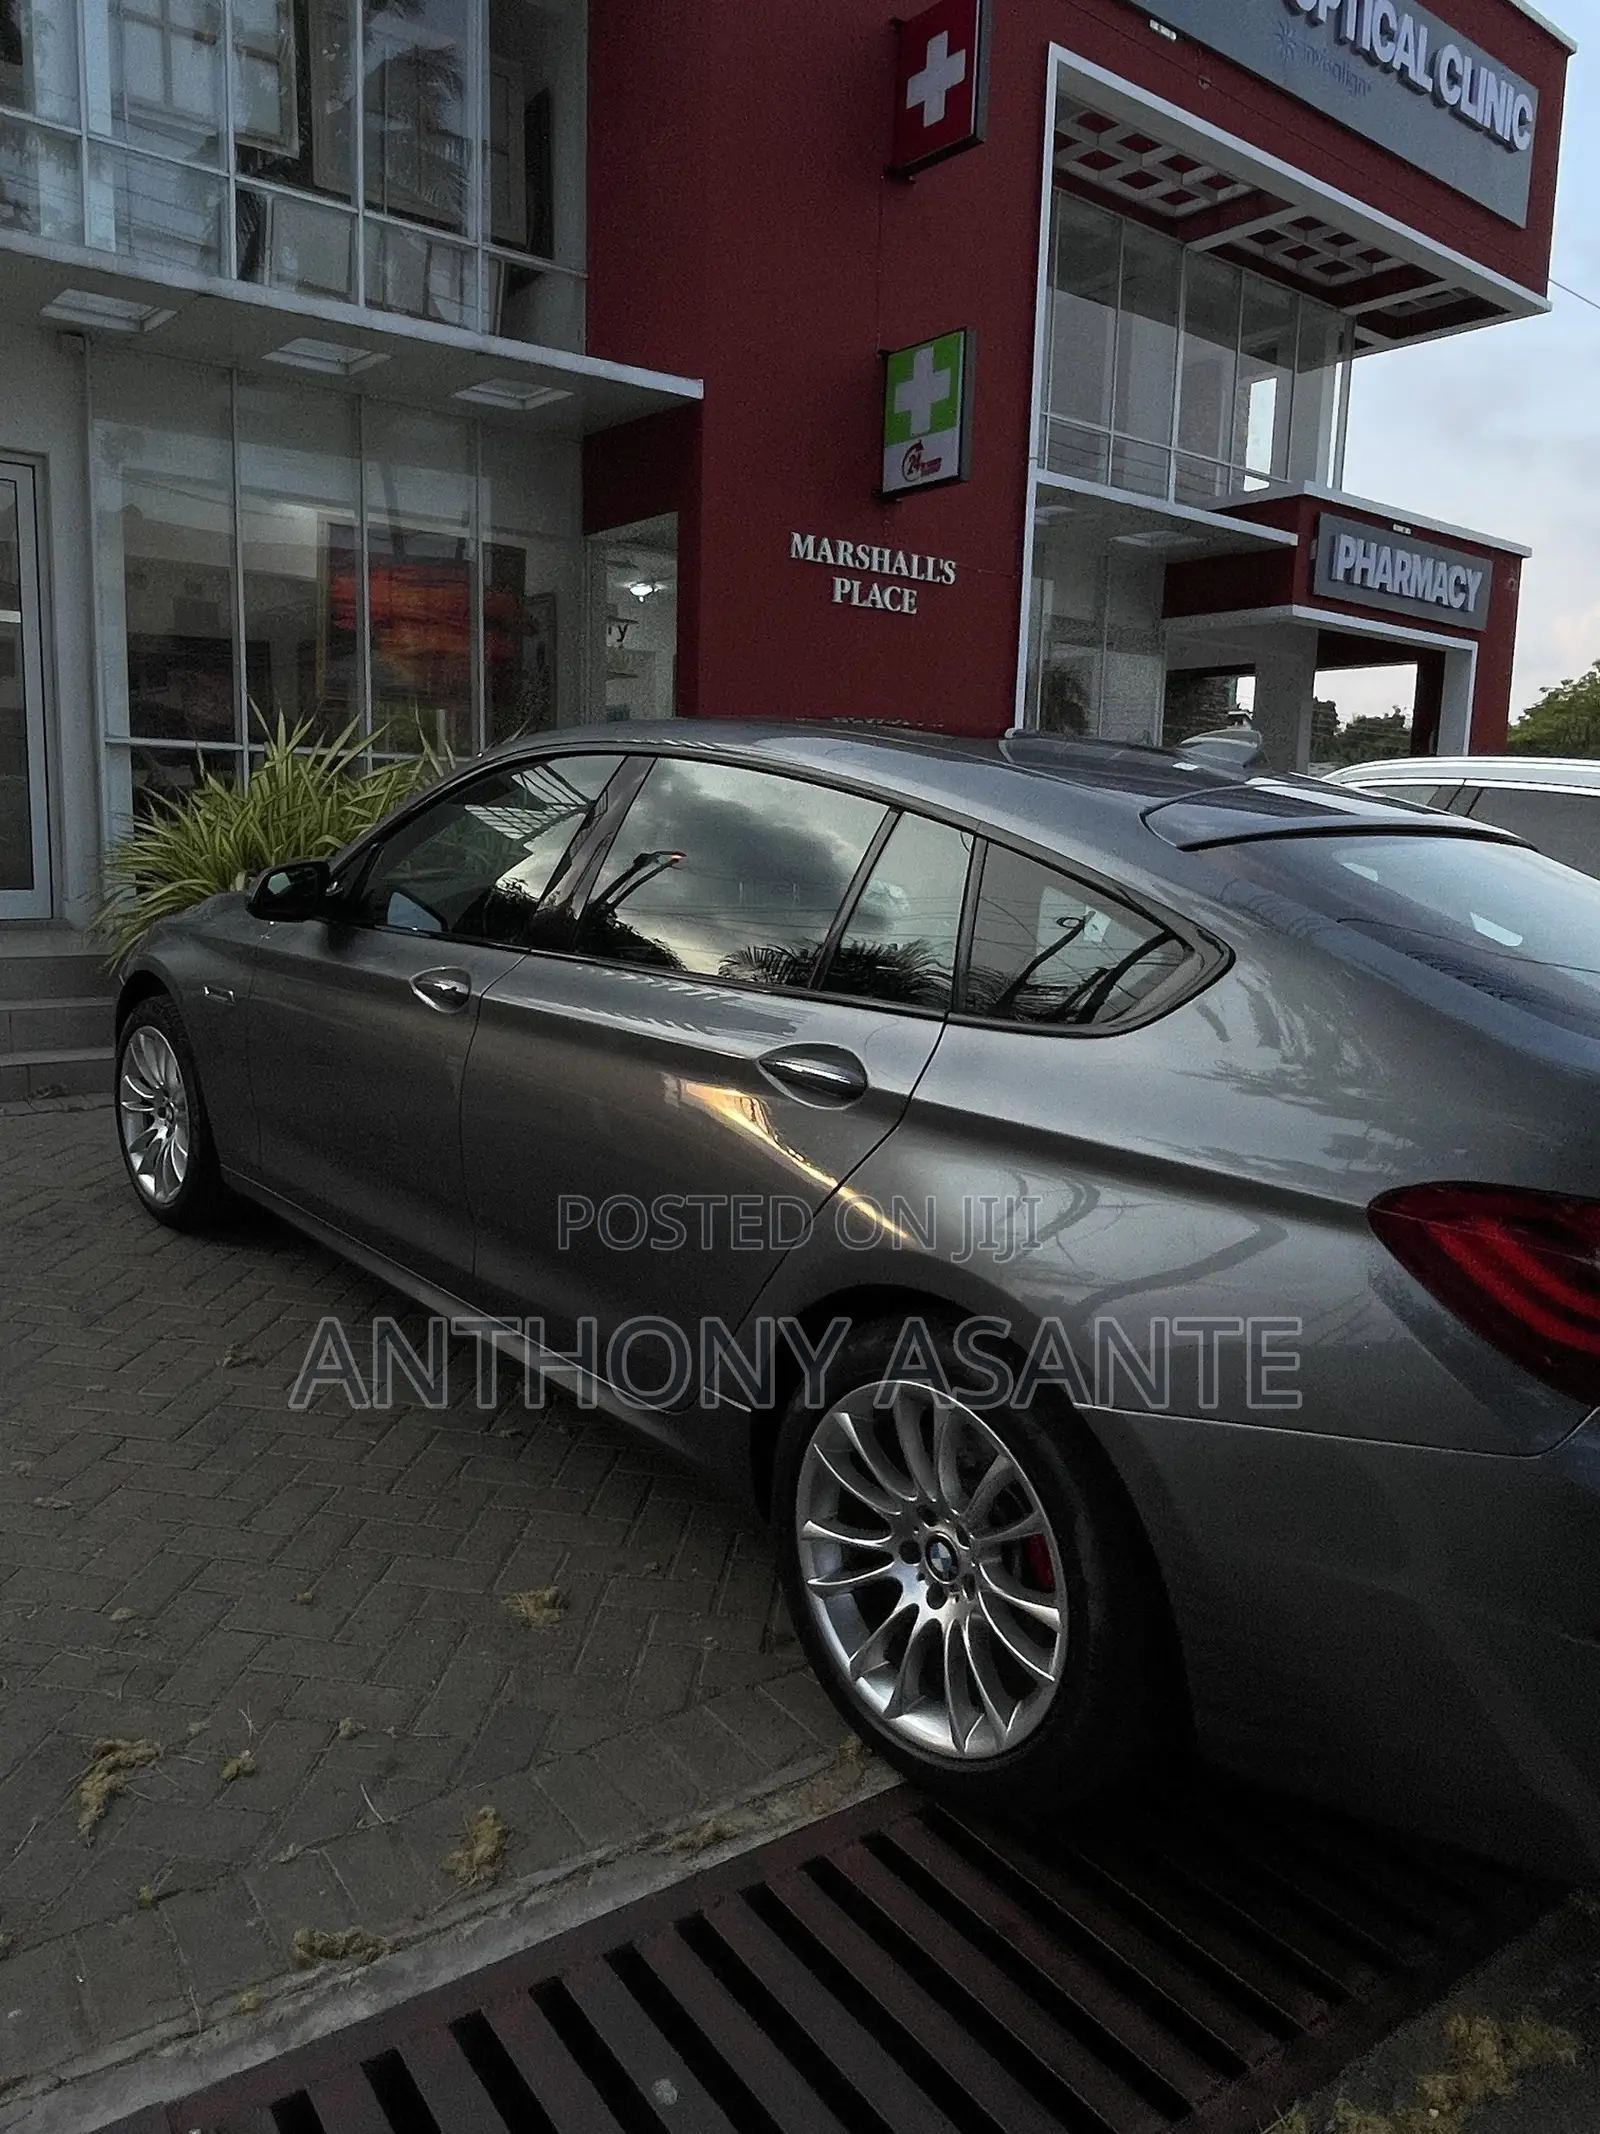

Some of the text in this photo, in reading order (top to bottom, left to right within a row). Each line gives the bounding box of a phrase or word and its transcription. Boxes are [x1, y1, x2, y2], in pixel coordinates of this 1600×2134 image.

[1296, 0, 1533, 151] TICAL CLINIC
[790, 531, 957, 585] MARSHALL'S
[1333, 533, 1483, 612] PHARMACY
[832, 576, 918, 616] PLACE
